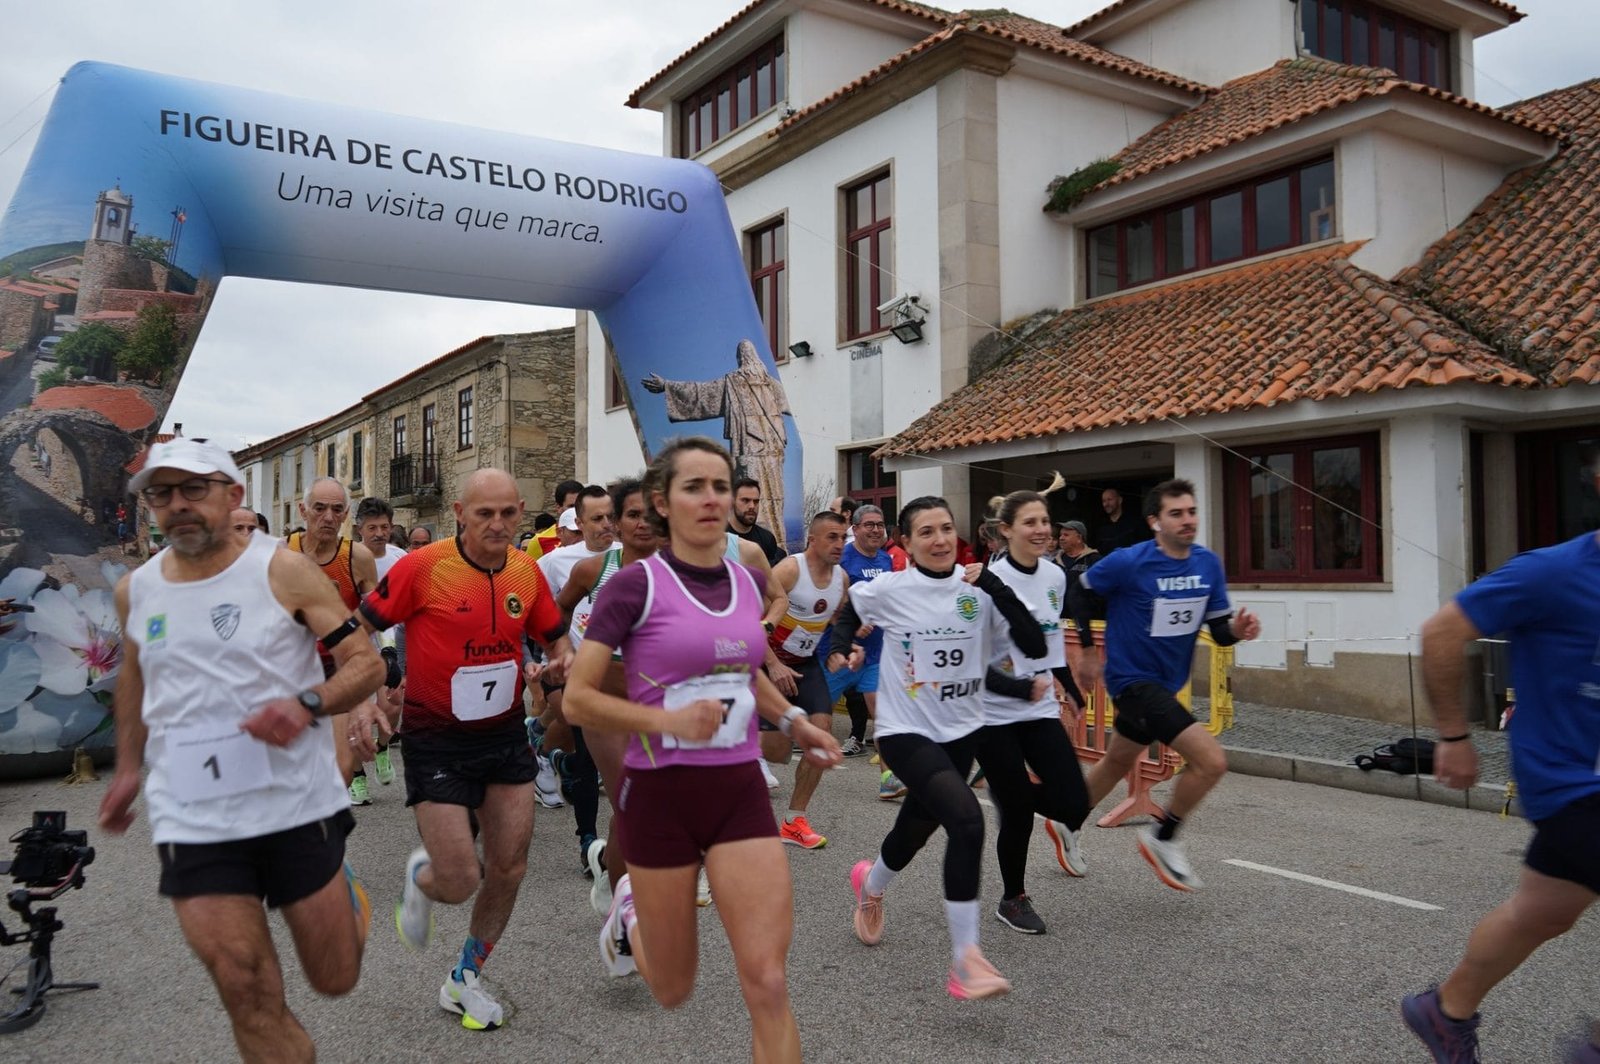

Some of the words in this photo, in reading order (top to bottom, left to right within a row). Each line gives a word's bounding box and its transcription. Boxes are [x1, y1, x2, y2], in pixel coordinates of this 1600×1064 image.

[160, 109, 336, 161] FIGUEIRA
[347, 139, 393, 169] DE
[402, 149, 546, 192] CASTELO
[555, 172, 688, 213] RODRIGO
[277, 172, 353, 209] Uma
[366, 188, 444, 222] visita
[455, 206, 509, 232] que
[518, 215, 603, 244] marca.
[851, 345, 882, 361] CINEMA
[1169, 610, 1193, 625] 33
[933, 648, 964, 668] 39
[482, 681, 497, 701] 7
[940, 678, 982, 701] RUN
[203, 755, 221, 781] 1
